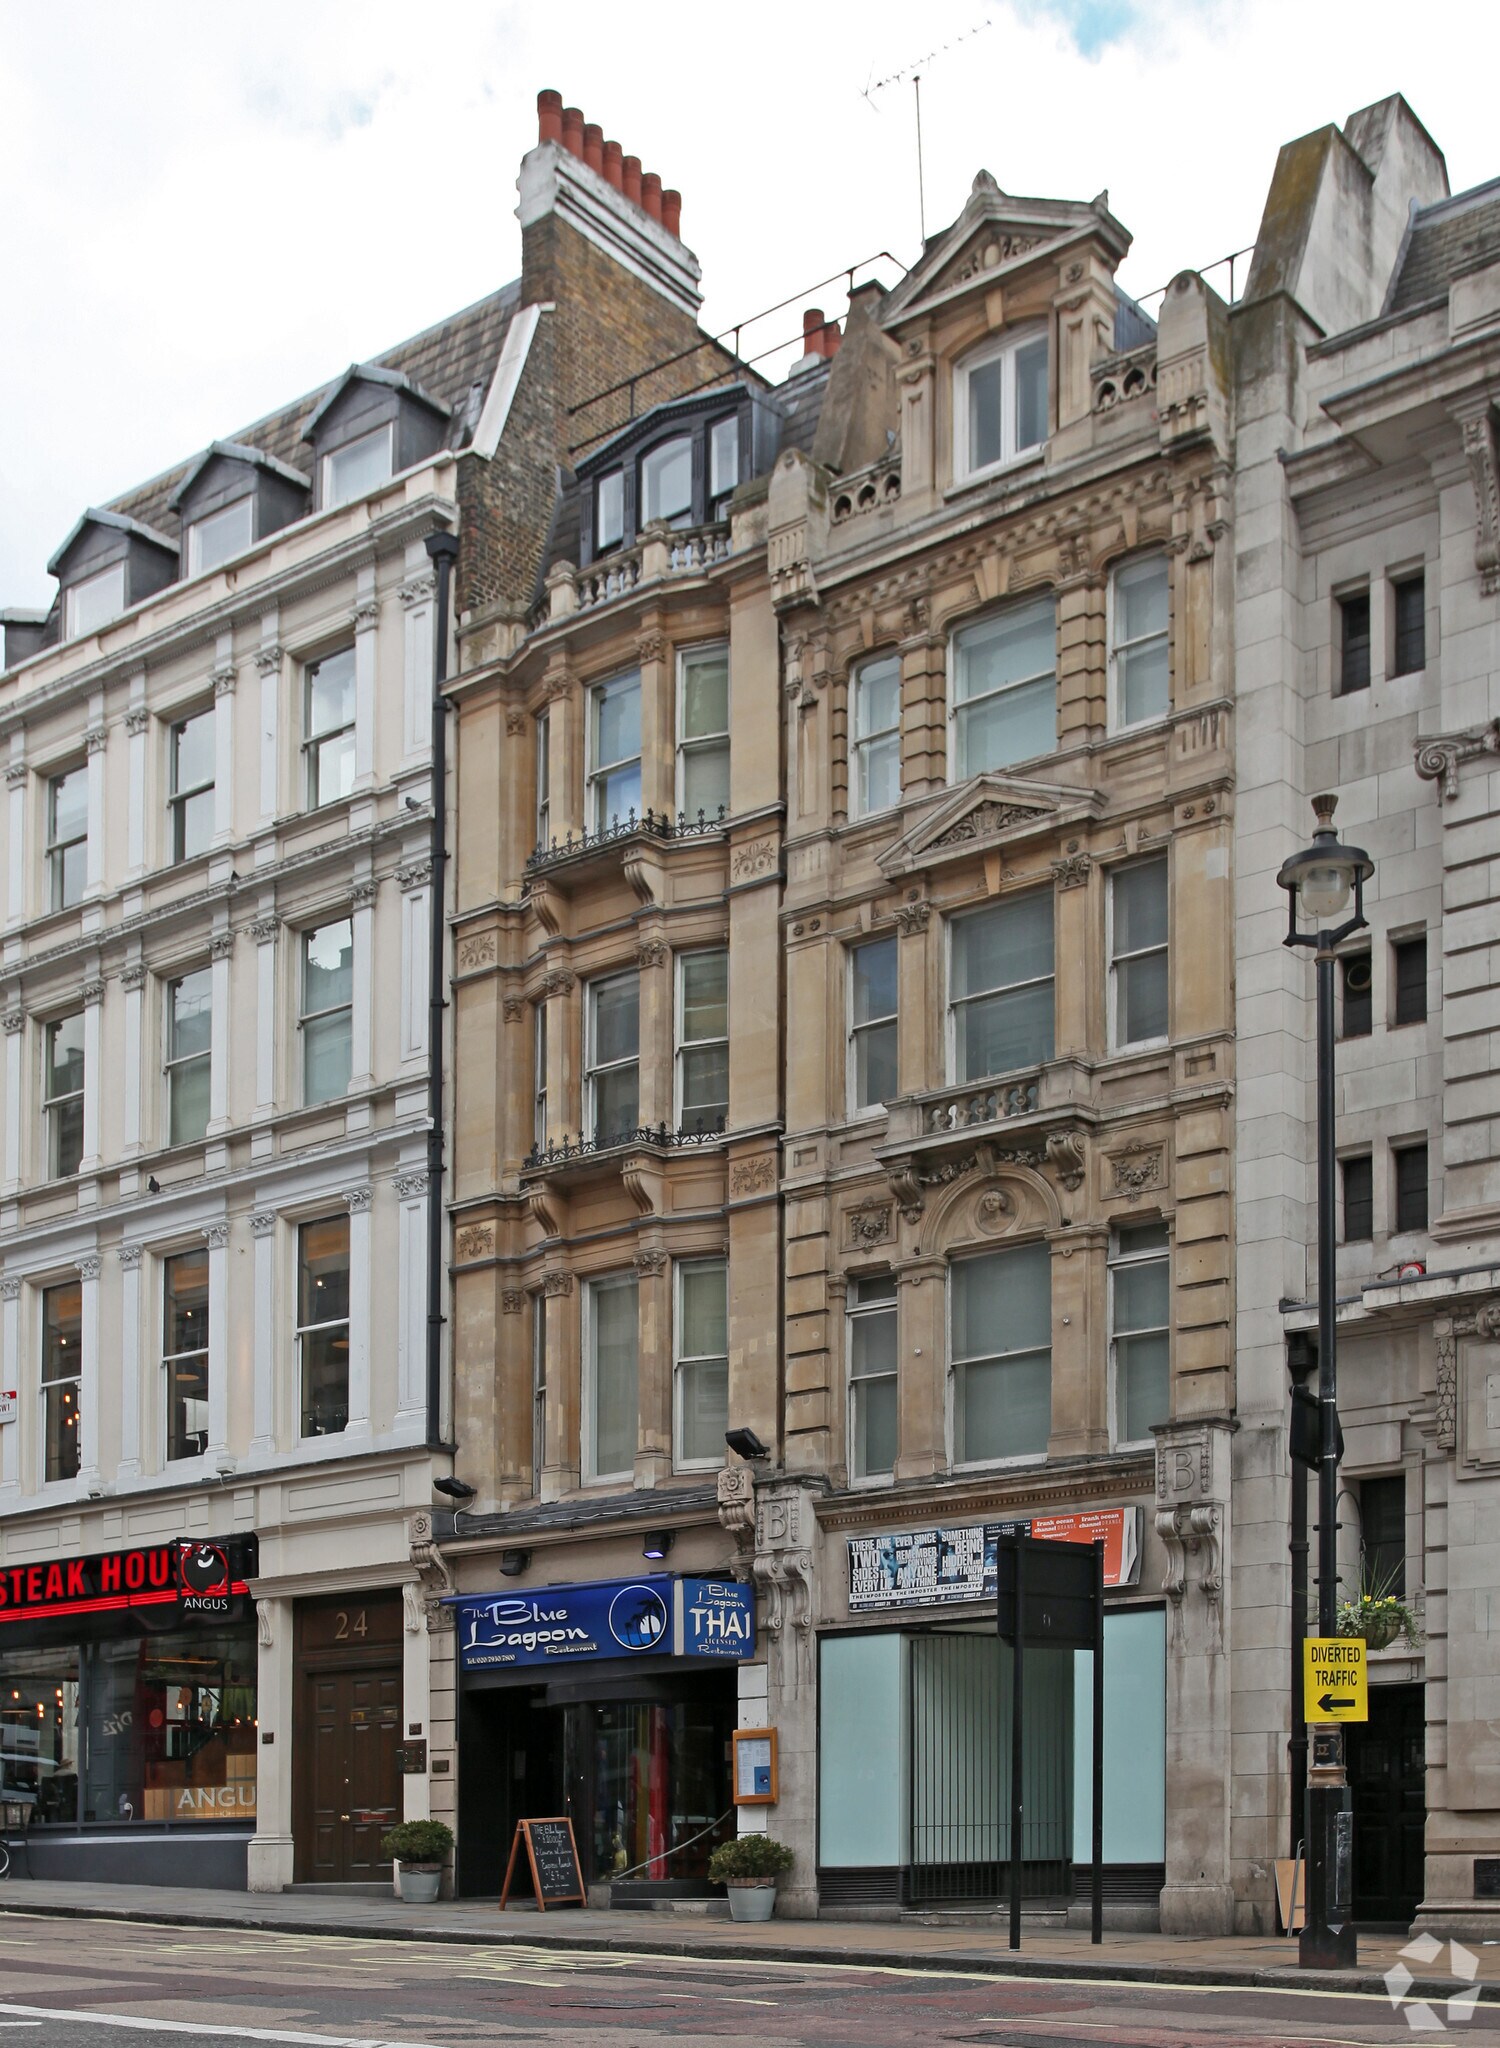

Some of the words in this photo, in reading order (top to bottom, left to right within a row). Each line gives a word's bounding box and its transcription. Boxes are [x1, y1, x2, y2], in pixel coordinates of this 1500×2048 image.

[1172, 1451, 1195, 1491] B
[768, 1505, 787, 1540] B
[895, 1535, 913, 1548] EVER
[914, 1532, 937, 1546] SINCE
[941, 1528, 984, 1542] SOMETHING
[852, 1539, 876, 1552] THERE
[876, 1537, 893, 1550] ARE
[955, 1539, 984, 1555] BEING
[852, 1550, 880, 1569] TWO
[942, 1554, 973, 1568] HIDDEN
[101, 1546, 192, 1592] HOU
[852, 1567, 879, 1581] SIDES
[963, 1564, 984, 1576] KNOW
[706, 1584, 738, 1598] Blue
[853, 1579, 879, 1593] EVERY
[184, 1597, 228, 1610] ANGUS
[695, 1591, 746, 1609] Lagoon
[462, 1608, 489, 1619] The
[485, 1600, 568, 1626] Blue
[335, 1610, 368, 1640] 24
[689, 1608, 751, 1640] THAI
[463, 1621, 589, 1652] Lagoon
[544, 1642, 597, 1655] Restaurant
[697, 1644, 743, 1656] Restaurant
[1311, 1646, 1361, 1663] DIVERTED
[1315, 1670, 1358, 1687] TRAFFIC
